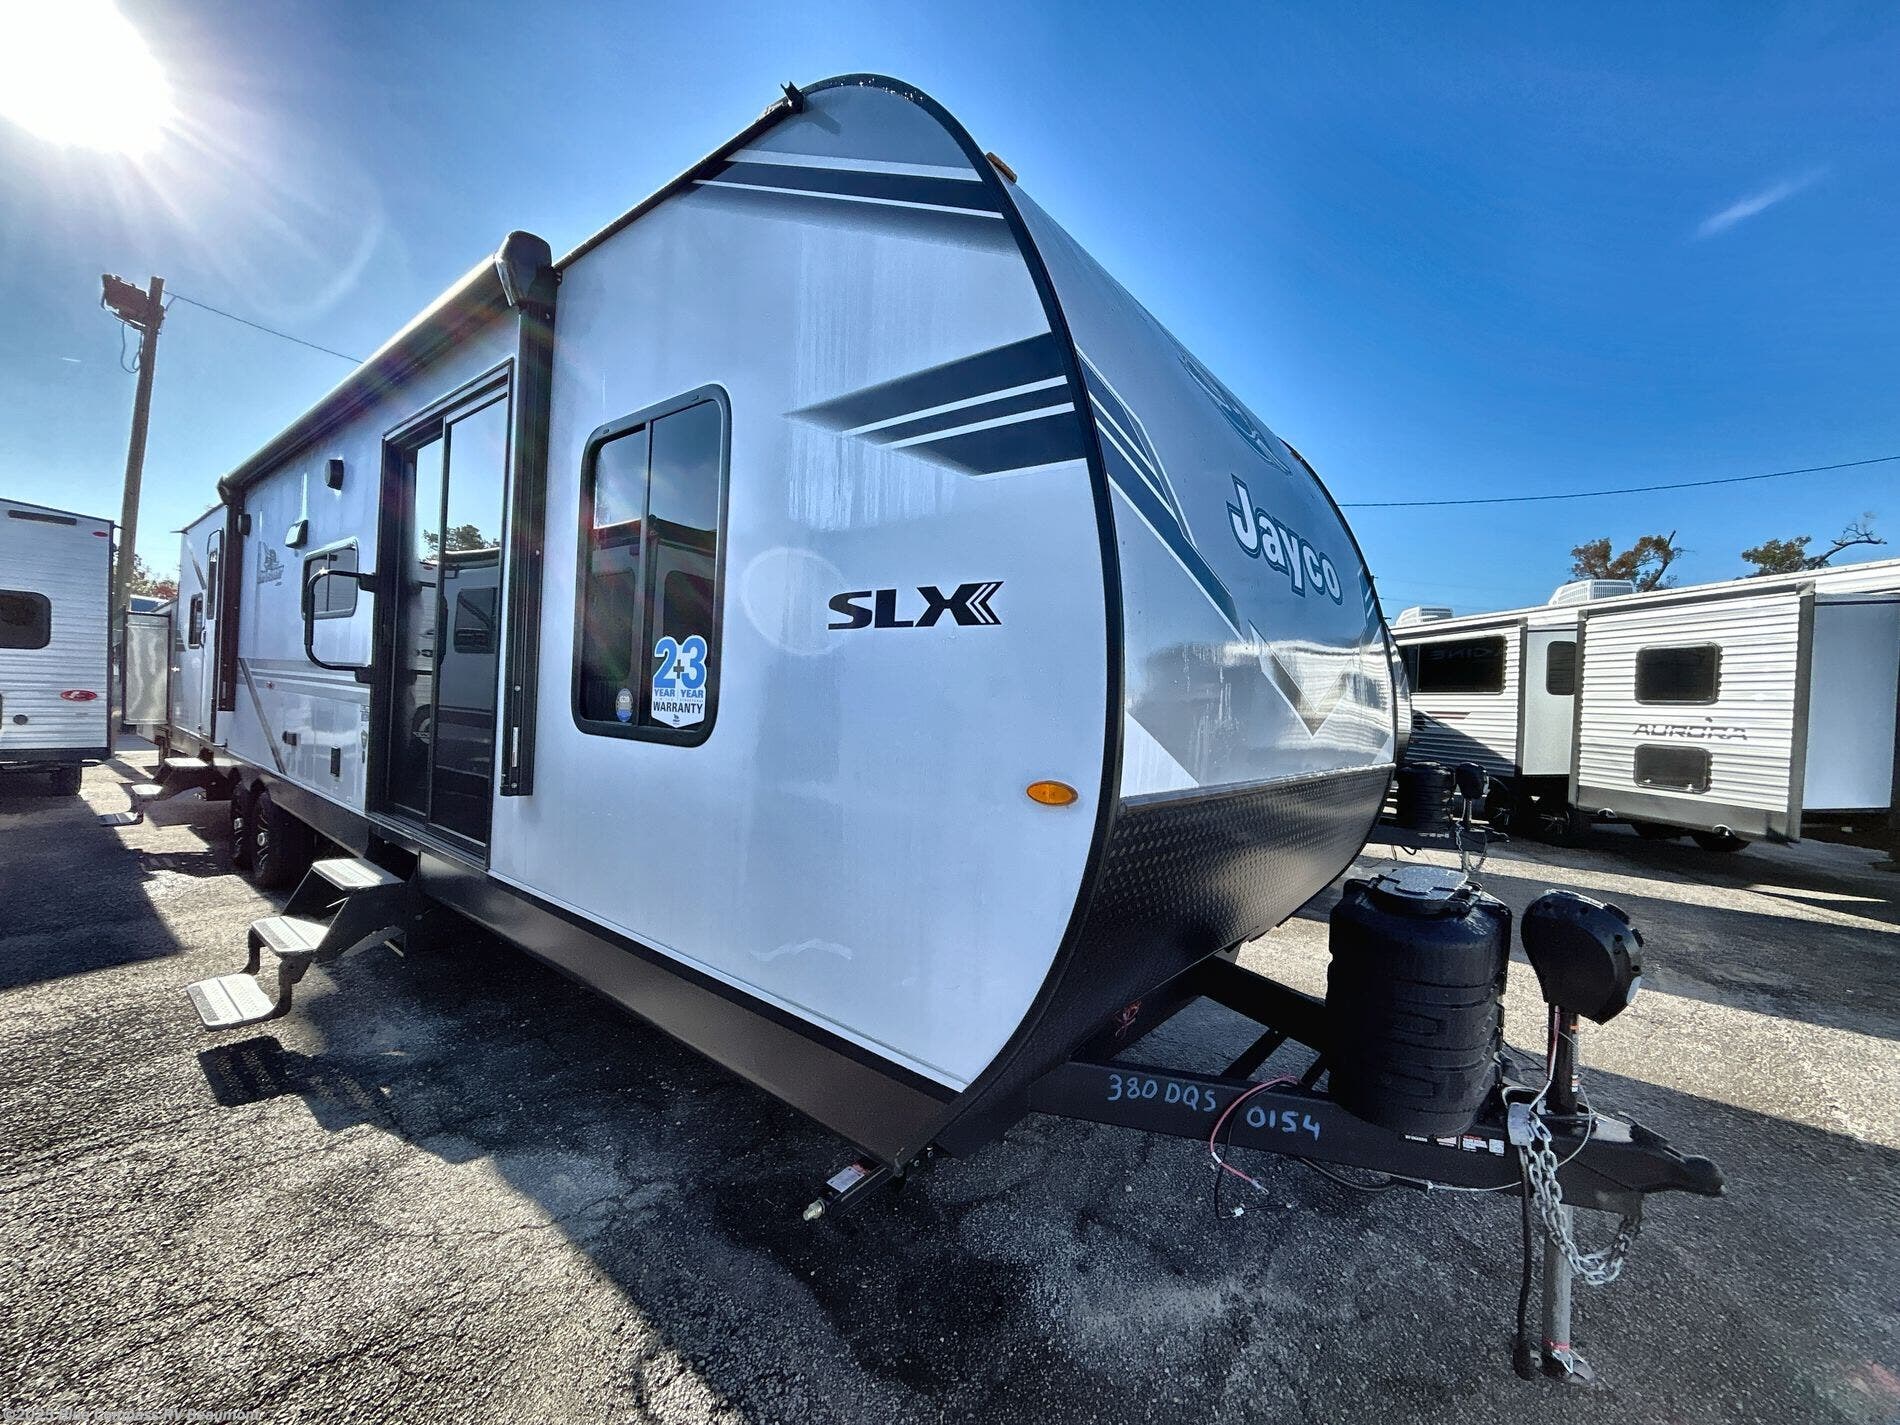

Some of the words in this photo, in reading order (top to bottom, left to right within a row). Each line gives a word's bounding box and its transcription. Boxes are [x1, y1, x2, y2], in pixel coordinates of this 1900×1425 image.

[1226, 473, 1342, 605] Jayco
[828, 581, 1004, 630] SLX
[654, 689, 676, 697] YEAR
[680, 689, 704, 698] YEAR
[653, 701, 703, 714] WARRANTY
[1633, 723, 1747, 740] AURORA
[1108, 1074, 1158, 1101] 380
[1164, 1083, 1216, 1112] DQS
